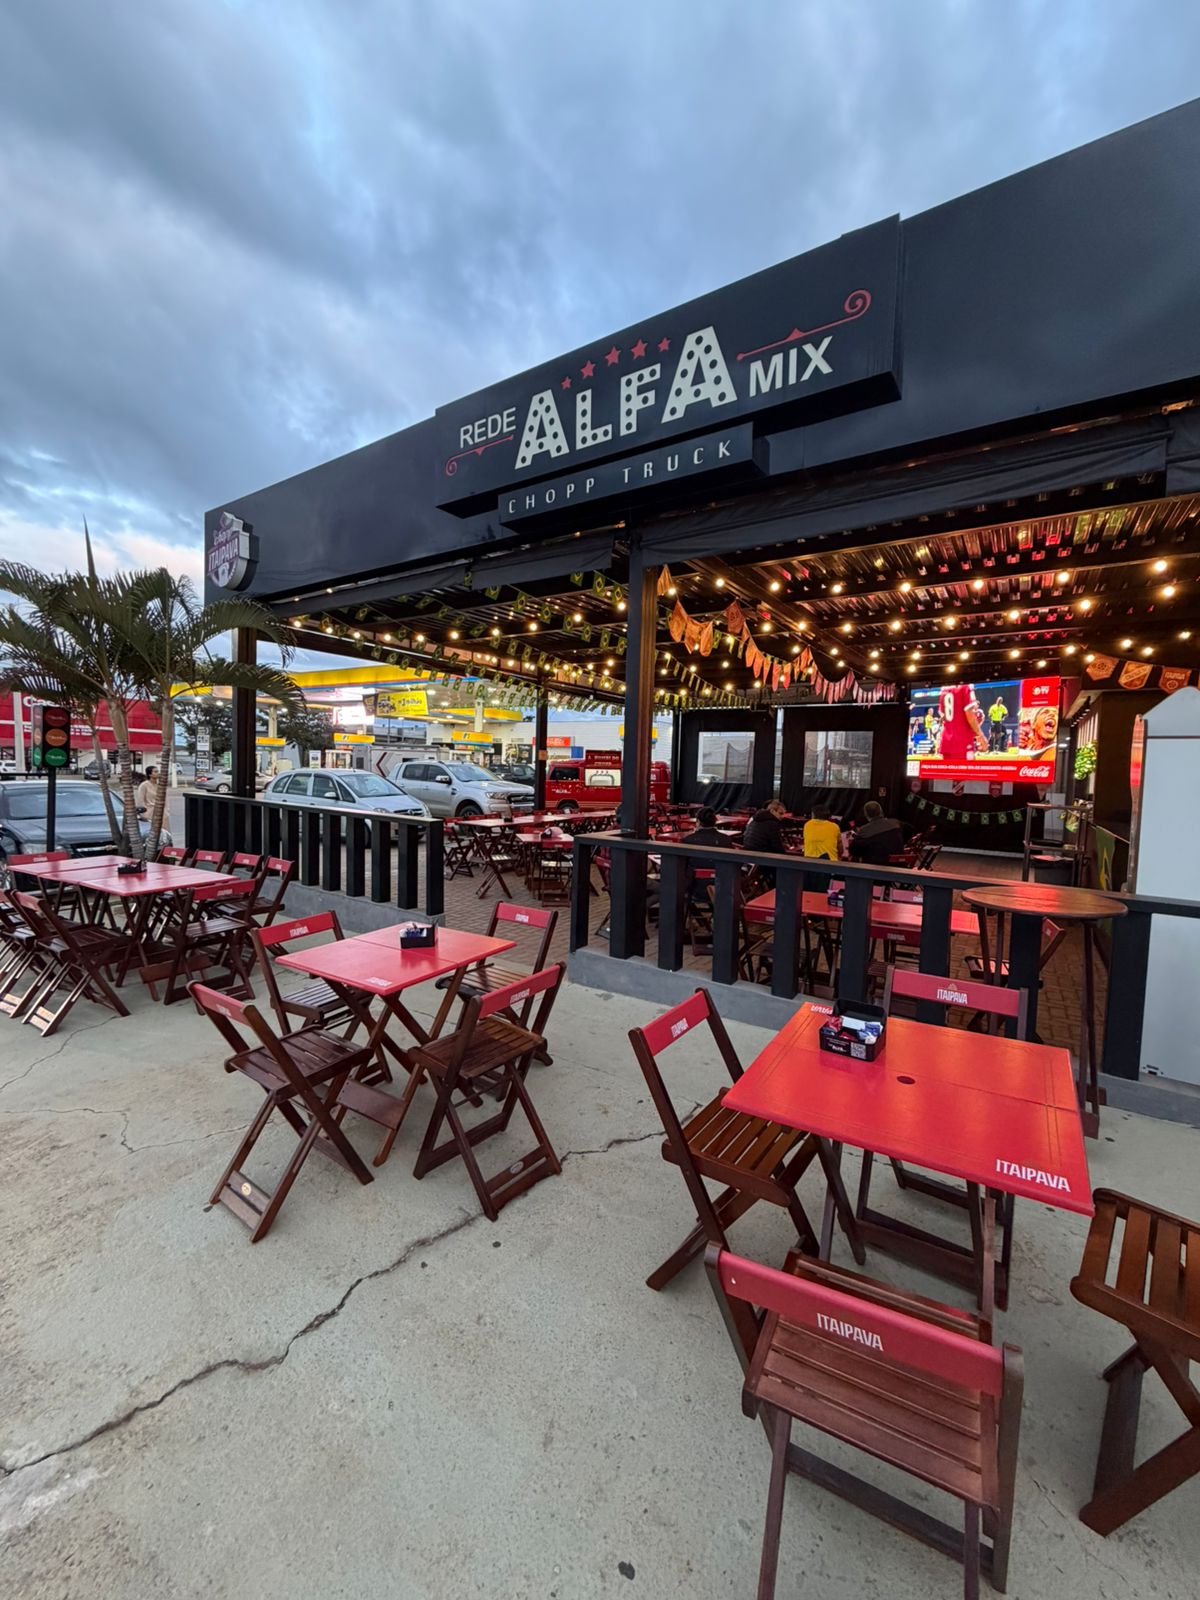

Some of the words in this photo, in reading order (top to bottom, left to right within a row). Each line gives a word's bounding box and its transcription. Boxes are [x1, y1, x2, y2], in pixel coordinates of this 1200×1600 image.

[460, 407, 516, 449] REDE
[514, 325, 738, 470] ALFA
[749, 335, 834, 398] MIX
[508, 477, 595, 514] CHOPP
[622, 439, 731, 484] TRUCK
[208, 536, 239, 572] ITAIPAVA
[937, 989, 968, 1005] ITAIPAVA
[995, 1159, 1071, 1193] ITAIPAVA
[817, 1312, 884, 1352] ITAIPAVA
